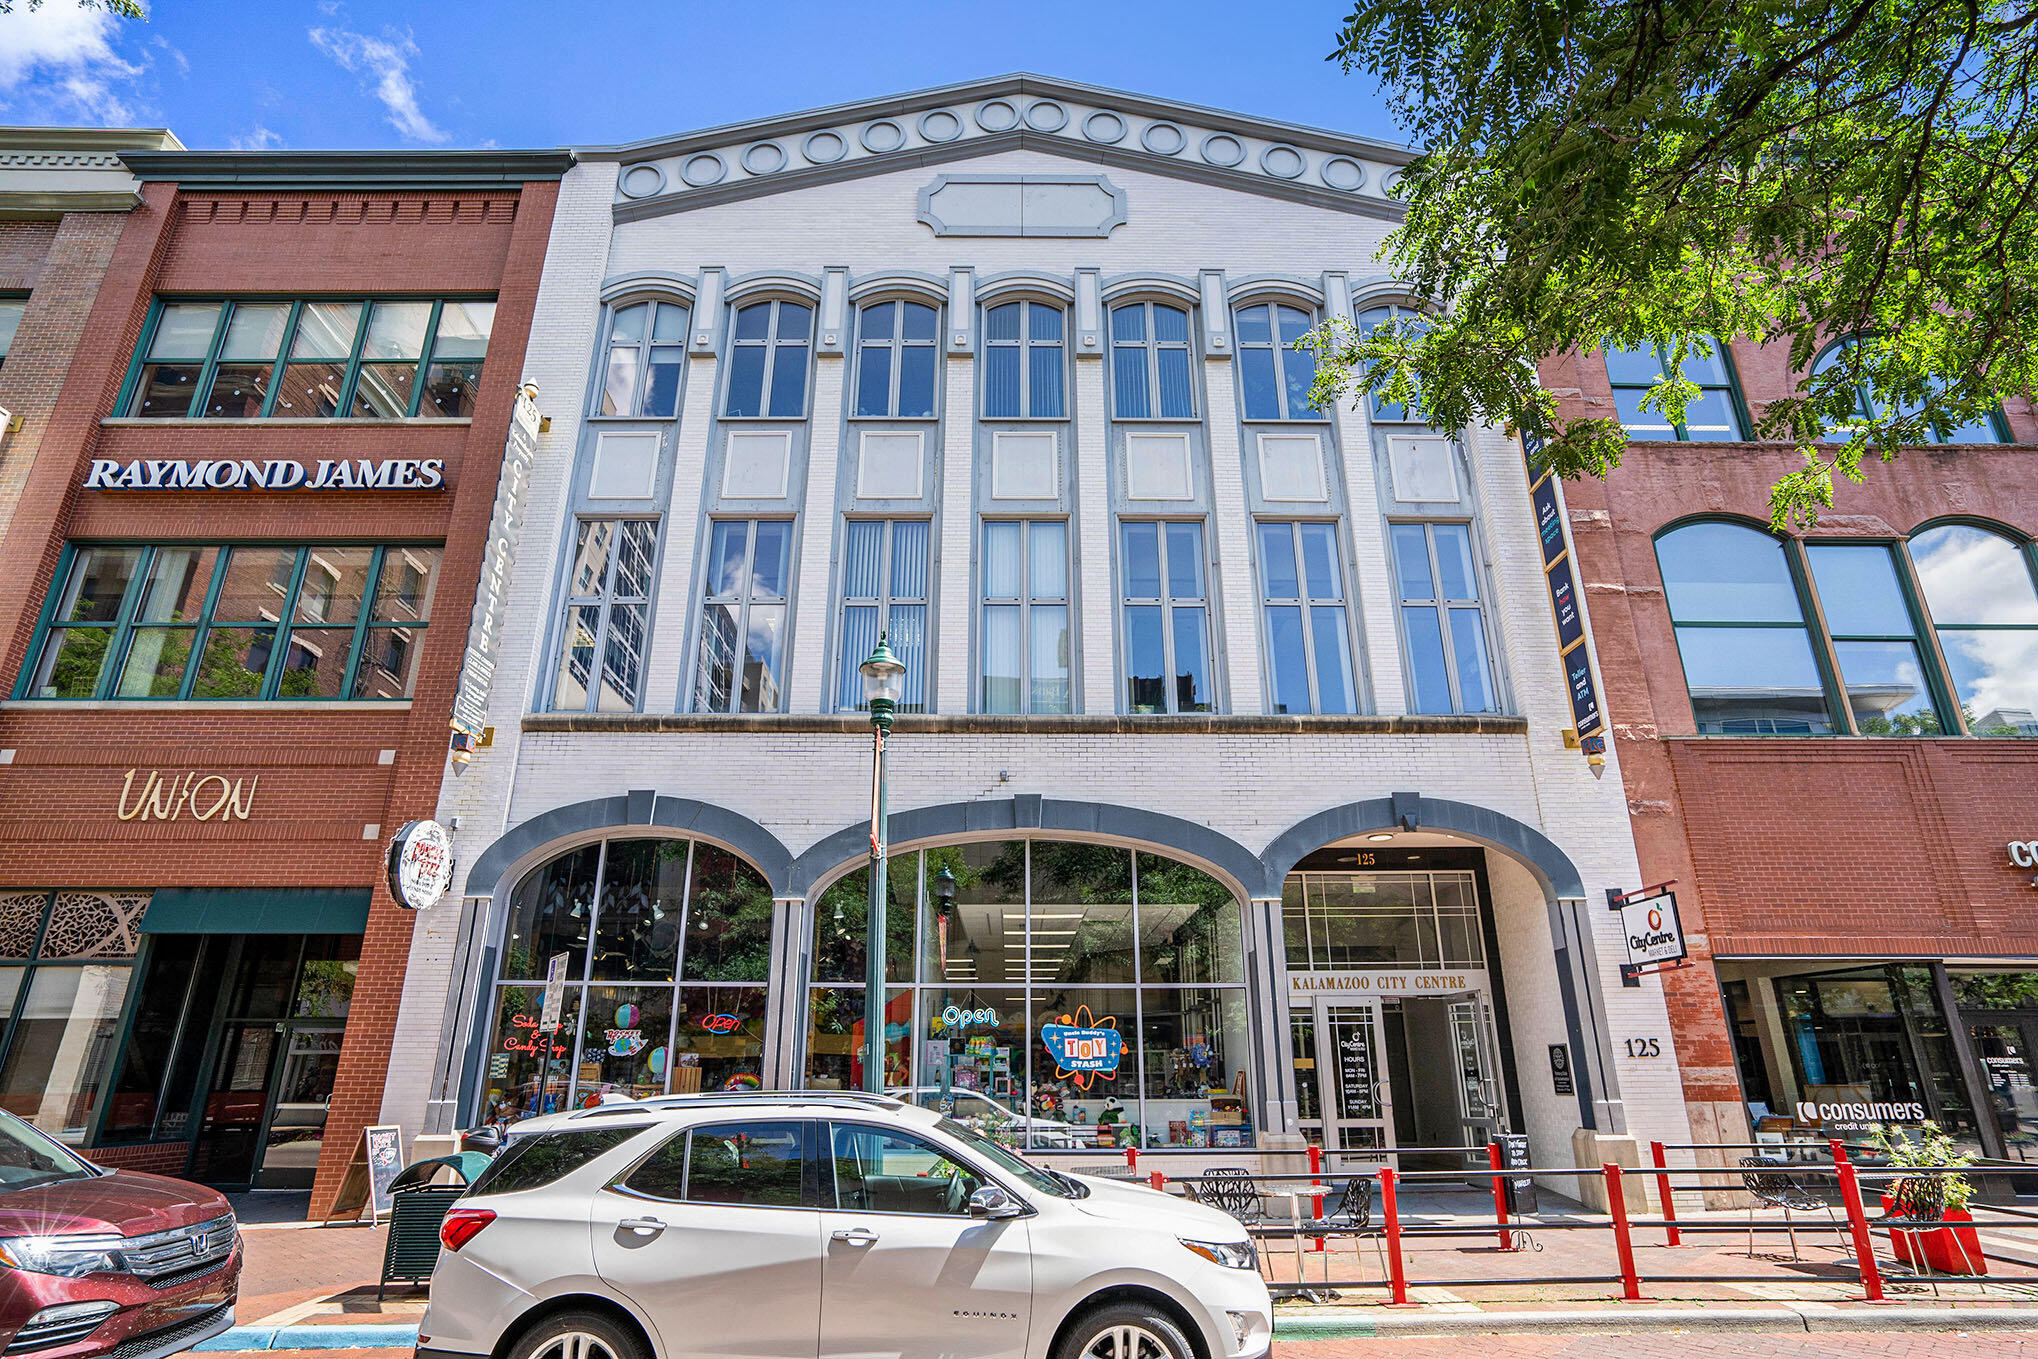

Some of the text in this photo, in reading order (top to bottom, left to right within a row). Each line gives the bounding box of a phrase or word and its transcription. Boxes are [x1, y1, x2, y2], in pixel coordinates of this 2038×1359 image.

[83, 459, 445, 490] RAYMOND JAMES
[504, 459, 522, 531] CITY
[1542, 502, 1551, 515] Ask
[1541, 509, 1555, 526] about
[1541, 516, 1560, 537] meeting
[1545, 528, 1559, 544] space
[479, 537, 509, 654] CENTRE
[1556, 582, 1569, 597] Bank
[1559, 594, 1569, 605] how
[1561, 604, 1571, 616] you
[1562, 611, 1575, 626] want
[1572, 667, 1586, 681] Teller
[1575, 677, 1586, 690] and
[1578, 687, 1589, 701] ATM
[1578, 710, 1599, 728] consumers
[118, 768, 259, 821] UNION
[1357, 853, 1376, 865] 125
[1630, 931, 1675, 952] CityCentre
[1292, 975, 1466, 990] KALAMAZOO CITY CENTRE
[512, 1014, 539, 1028] Soda
[702, 1013, 740, 1031] Open
[942, 1005, 1000, 1030] Open
[530, 1029, 541, 1040] &
[504, 1037, 538, 1057] Candy
[1067, 1039, 1104, 1058] TOY
[1624, 1038, 1660, 1058] 125
[1070, 1060, 1103, 1068] STASH
[1819, 1102, 1925, 1120] consumers
[1835, 1122, 1858, 1131] credit
[953, 1310, 1018, 1320] EQUINOX
